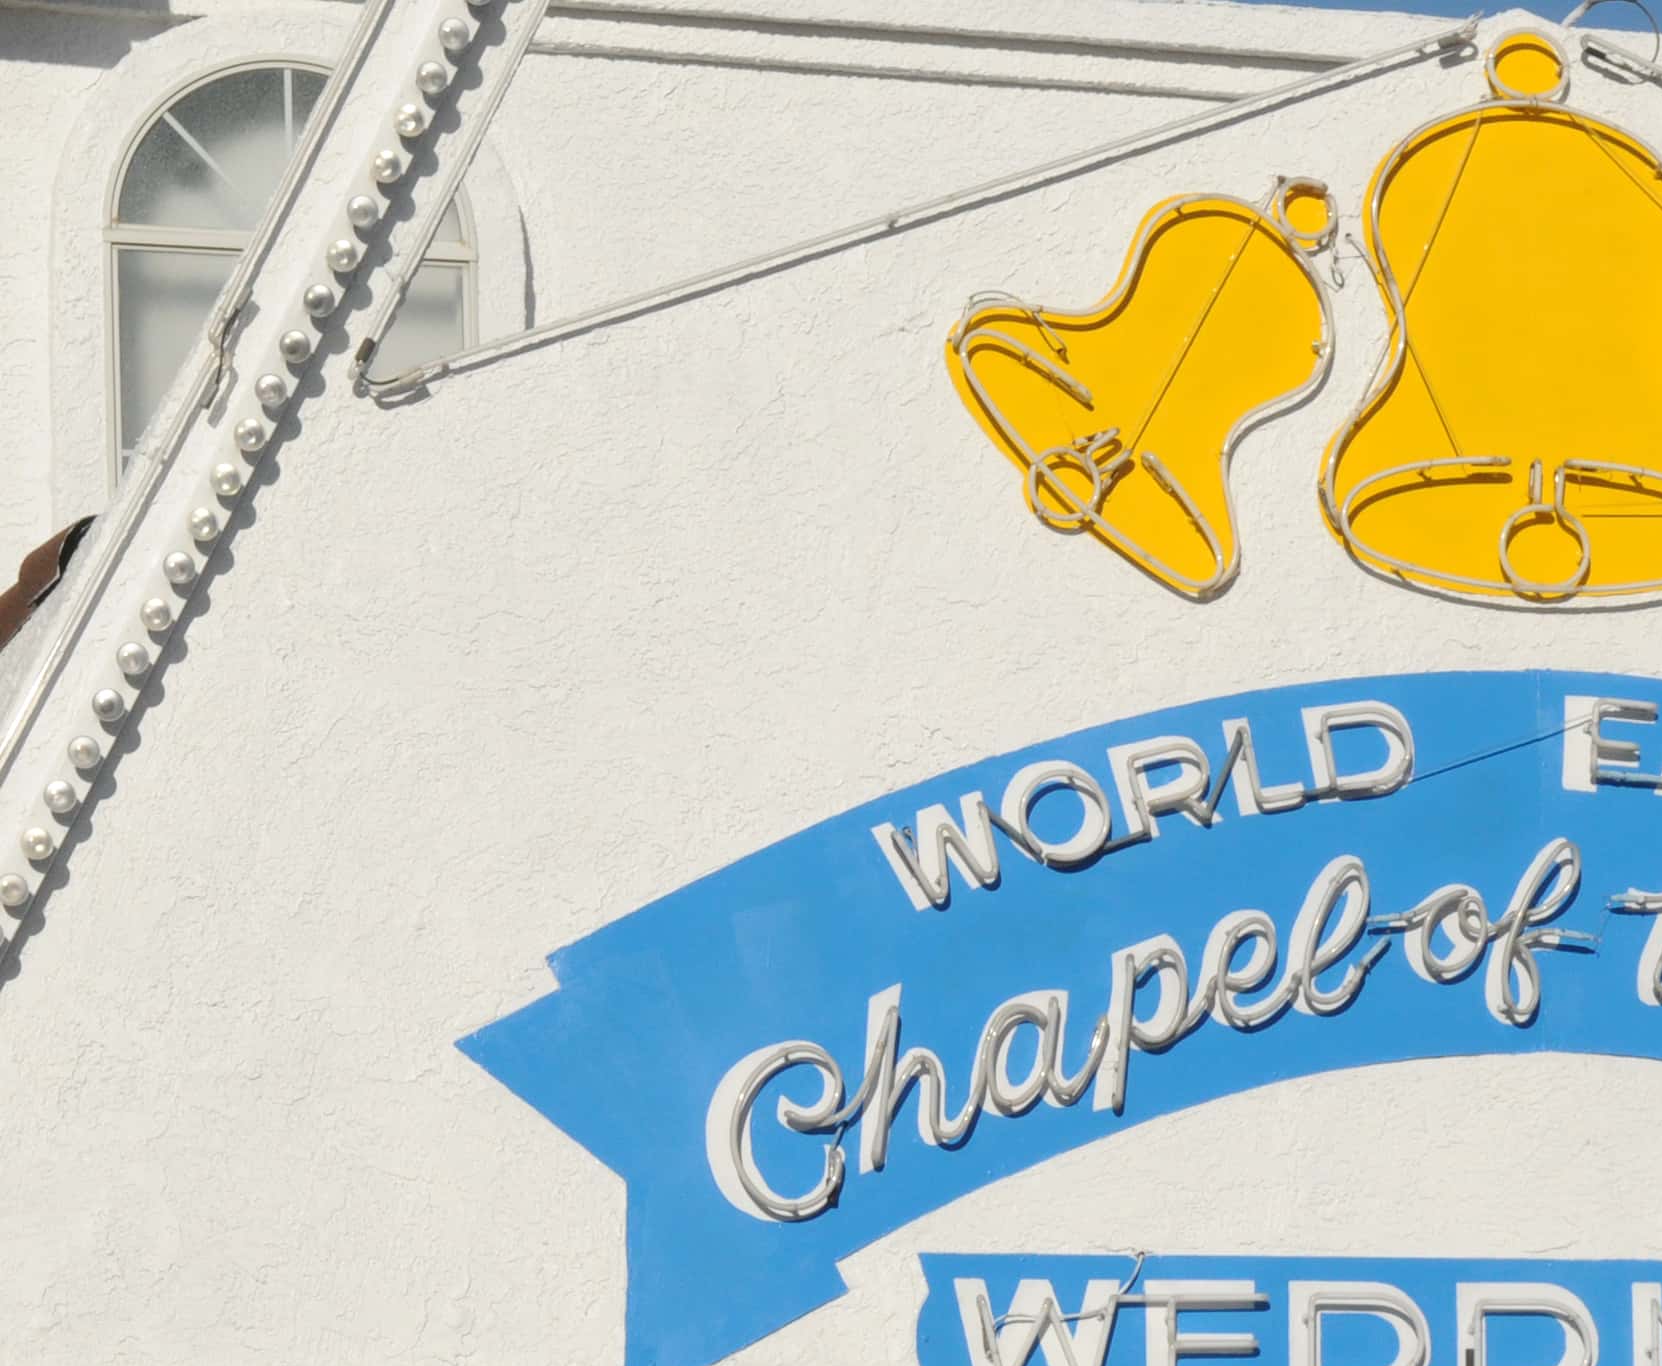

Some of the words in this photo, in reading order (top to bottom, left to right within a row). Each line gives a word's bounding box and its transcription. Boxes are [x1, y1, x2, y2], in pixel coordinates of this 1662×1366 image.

[871, 700, 1415, 912] WORLD
[705, 855, 1388, 1222] Chapel
[1402, 838, 1594, 1027] of
